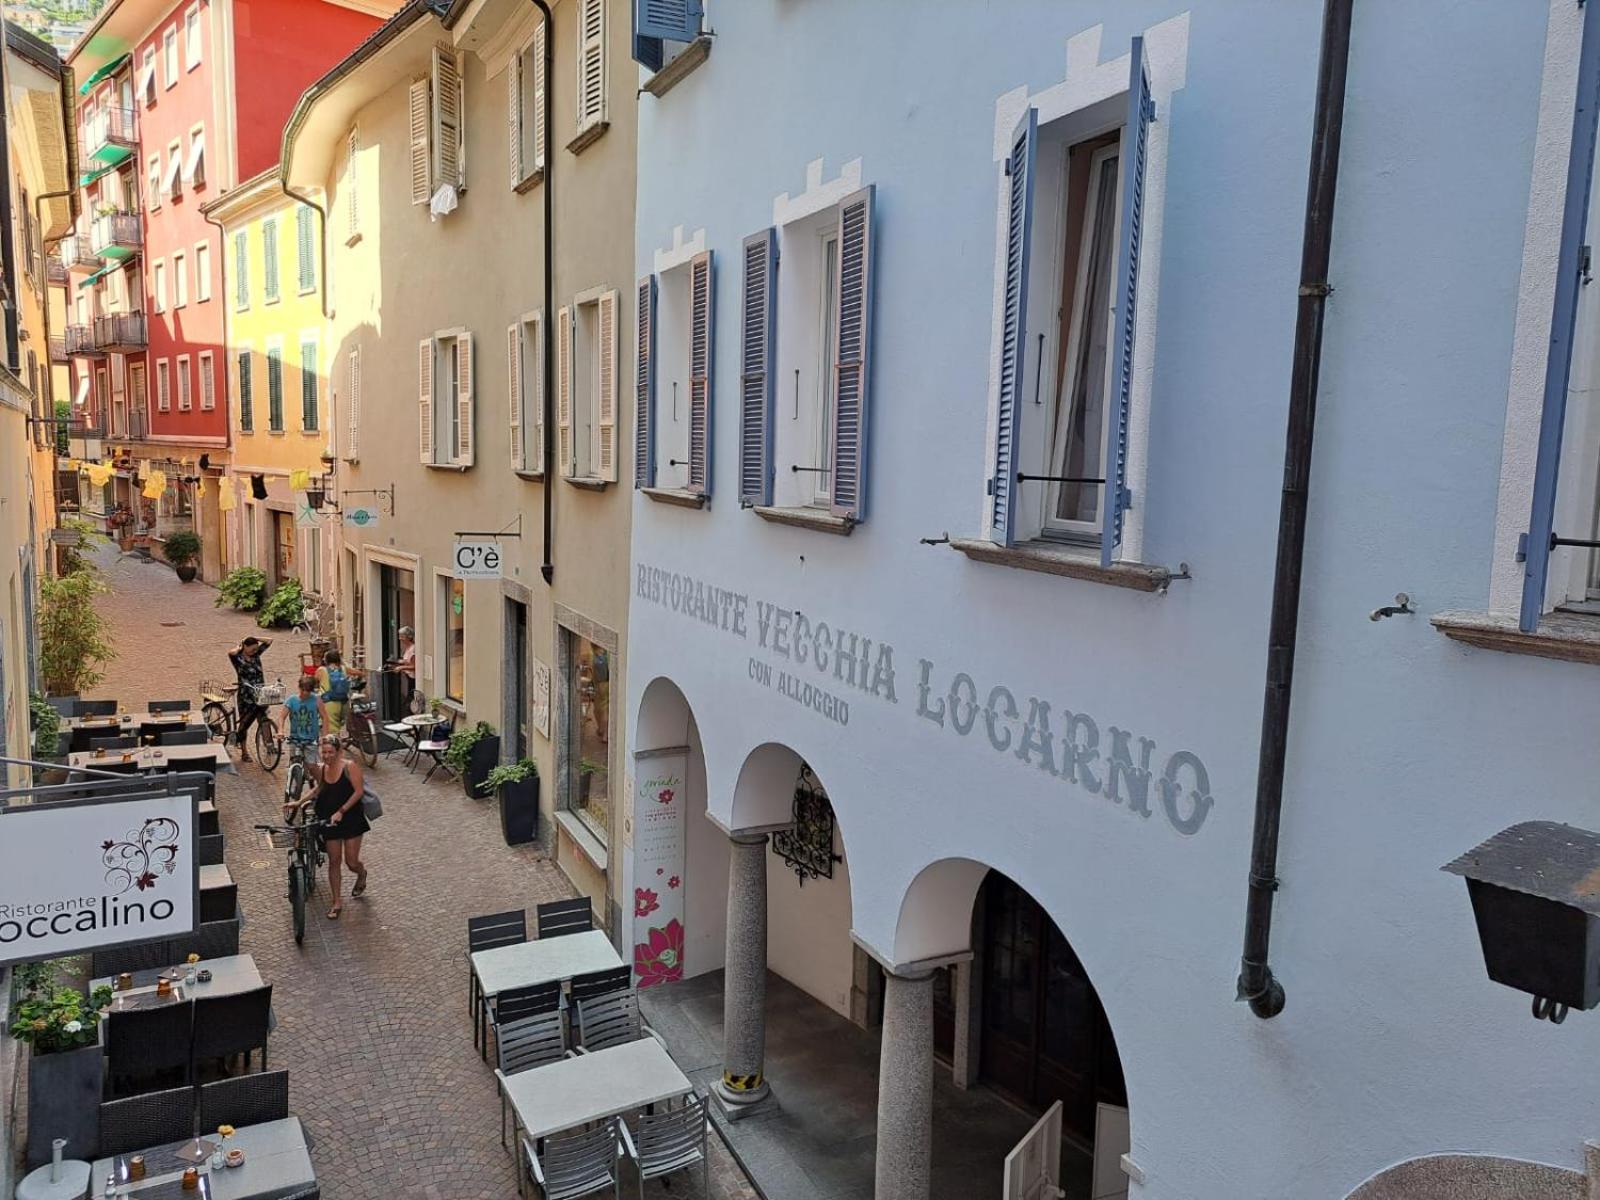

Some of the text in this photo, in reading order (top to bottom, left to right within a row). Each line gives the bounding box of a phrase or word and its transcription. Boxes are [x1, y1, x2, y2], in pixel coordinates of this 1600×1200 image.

[457, 546, 499, 569] C'è
[636, 562, 1214, 836] RISTORANTE VECCHIA LOCARNO
[749, 656, 849, 726] CON ALLOGGIO
[0, 896, 96, 918] Ristorante
